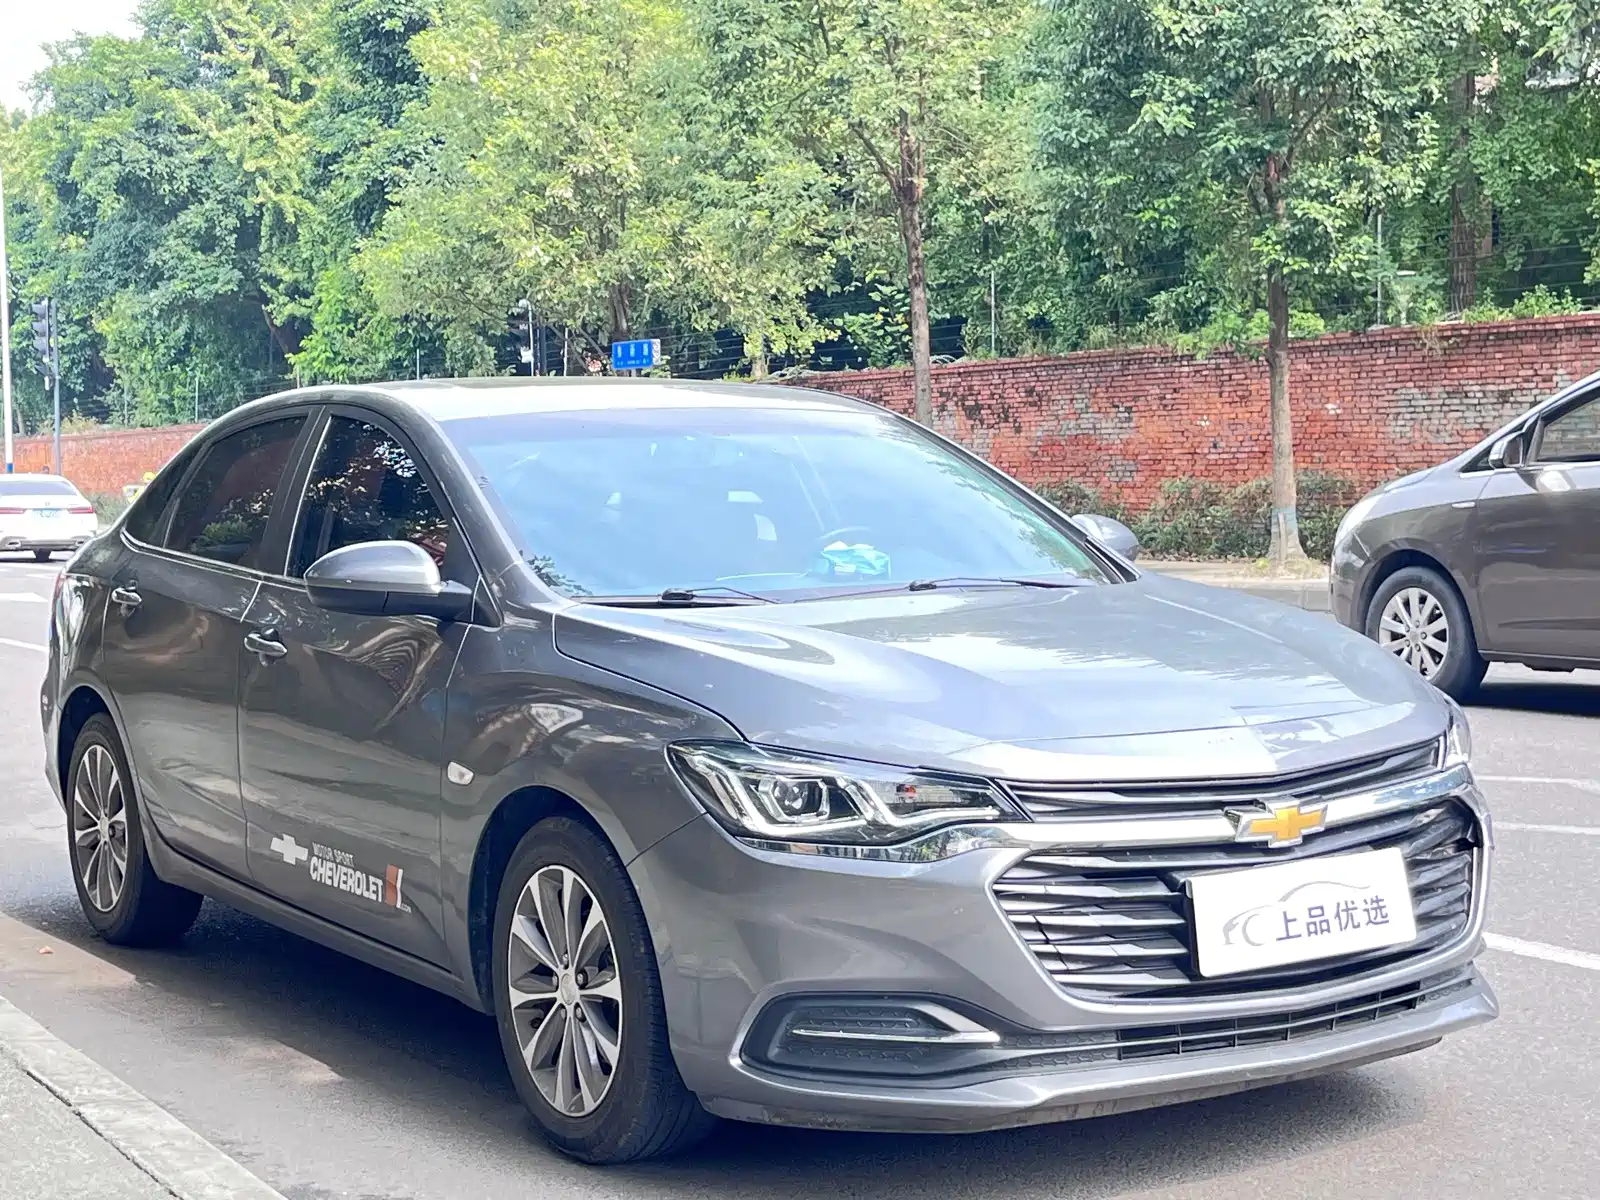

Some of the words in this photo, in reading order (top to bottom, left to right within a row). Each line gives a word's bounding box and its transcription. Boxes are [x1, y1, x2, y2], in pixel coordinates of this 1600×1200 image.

[310, 856, 383, 902] CHEVEROLET
[1275, 895, 1390, 942] 上品优选
